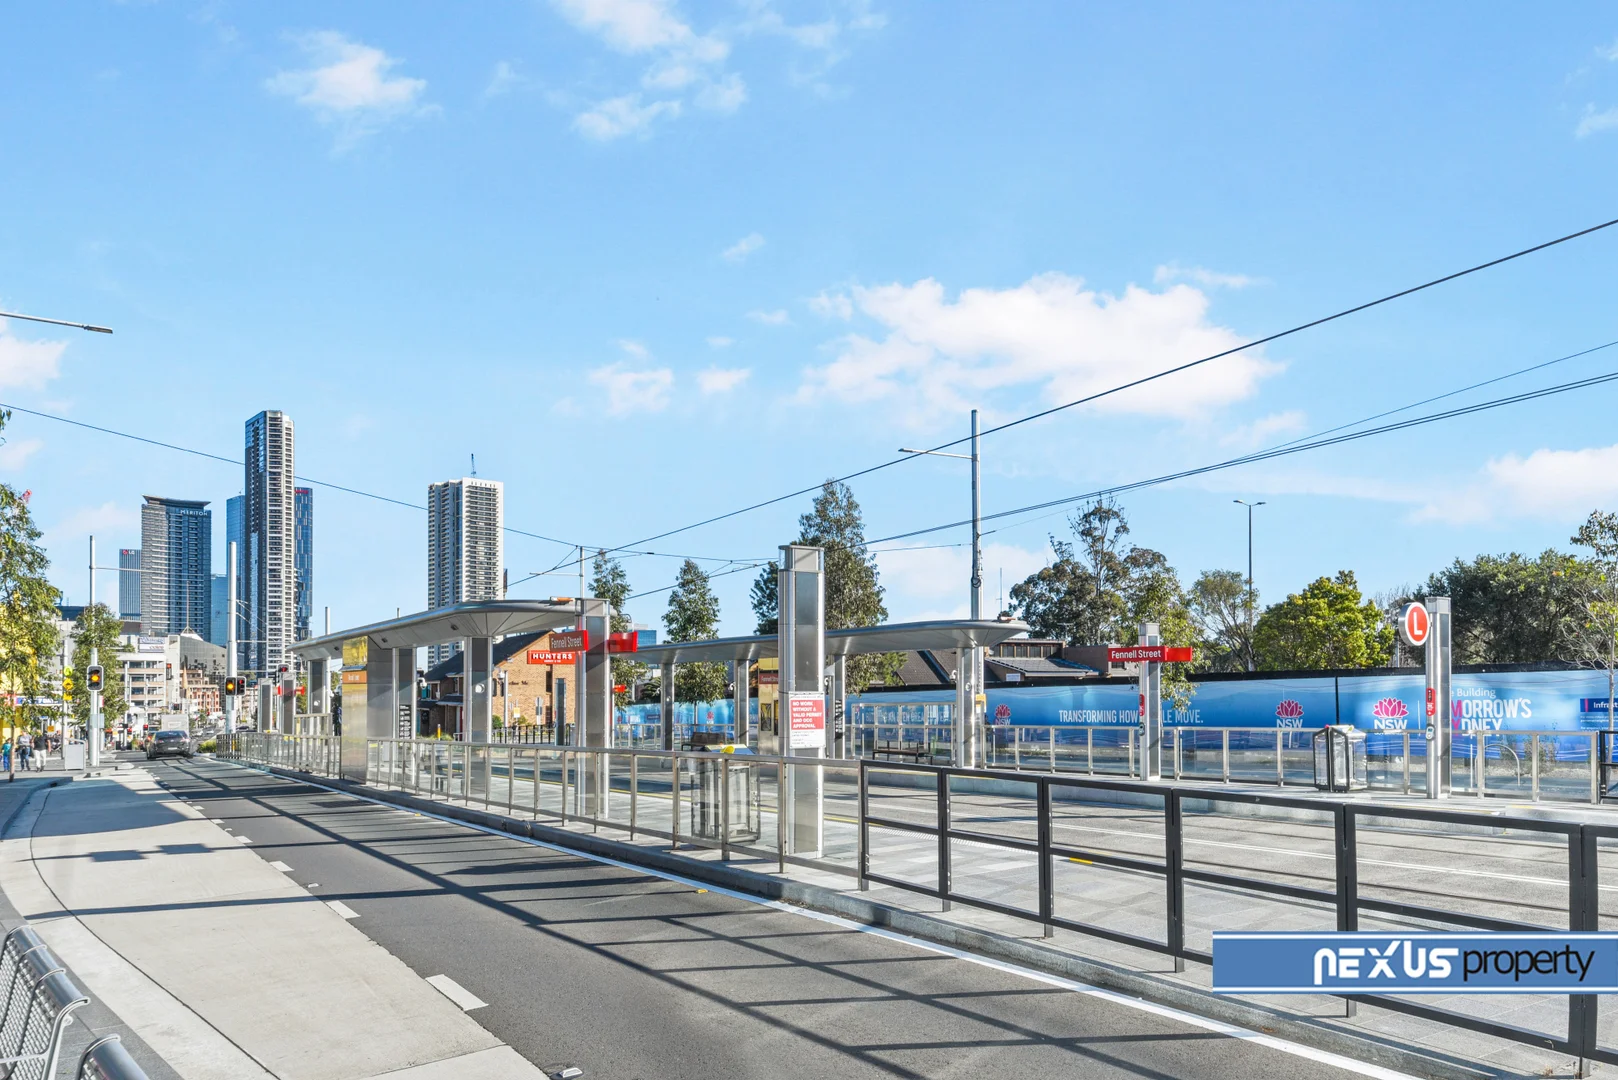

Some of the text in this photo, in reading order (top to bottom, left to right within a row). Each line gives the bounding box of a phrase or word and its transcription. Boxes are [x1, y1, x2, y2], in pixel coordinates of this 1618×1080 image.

[180, 509, 208, 517] MERITON
[1413, 611, 1423, 636] L
[551, 636, 582, 649] Fennell Street
[1111, 649, 1161, 659] Fennell Street
[1456, 687, 1497, 699] Building
[1451, 698, 1532, 719] MORROW'S
[995, 718, 1011, 726] NSW
[1059, 709, 1138, 724] TRANSFORMING HOW
[1175, 709, 1204, 724] MOVE.
[1276, 718, 1303, 729] NSW
[1374, 719, 1408, 731] NSW
[1451, 718, 1503, 737] YDNEY
